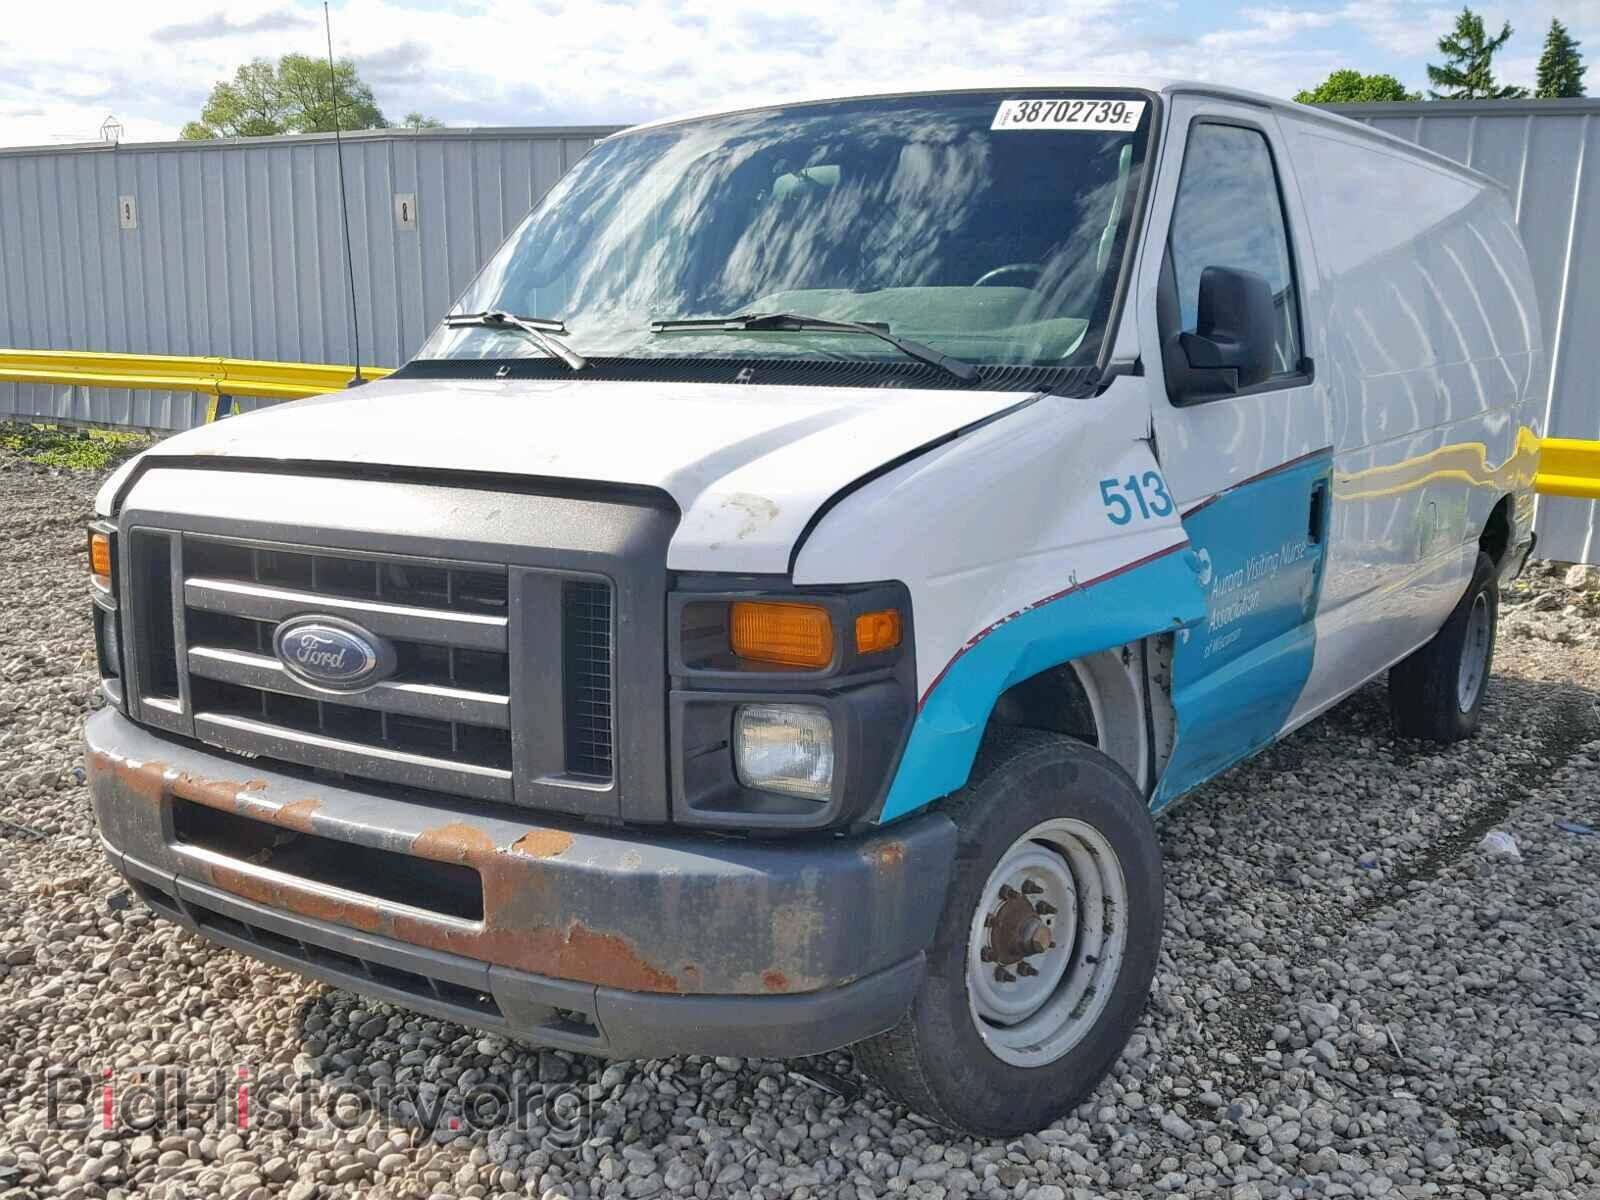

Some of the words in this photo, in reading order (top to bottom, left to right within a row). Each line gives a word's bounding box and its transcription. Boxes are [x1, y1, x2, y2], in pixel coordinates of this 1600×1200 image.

[1099, 470, 1173, 525] 513
[1211, 568, 1243, 599] Aurora
[1280, 542, 1306, 565] Nurse
[297, 634, 346, 668] Ford
